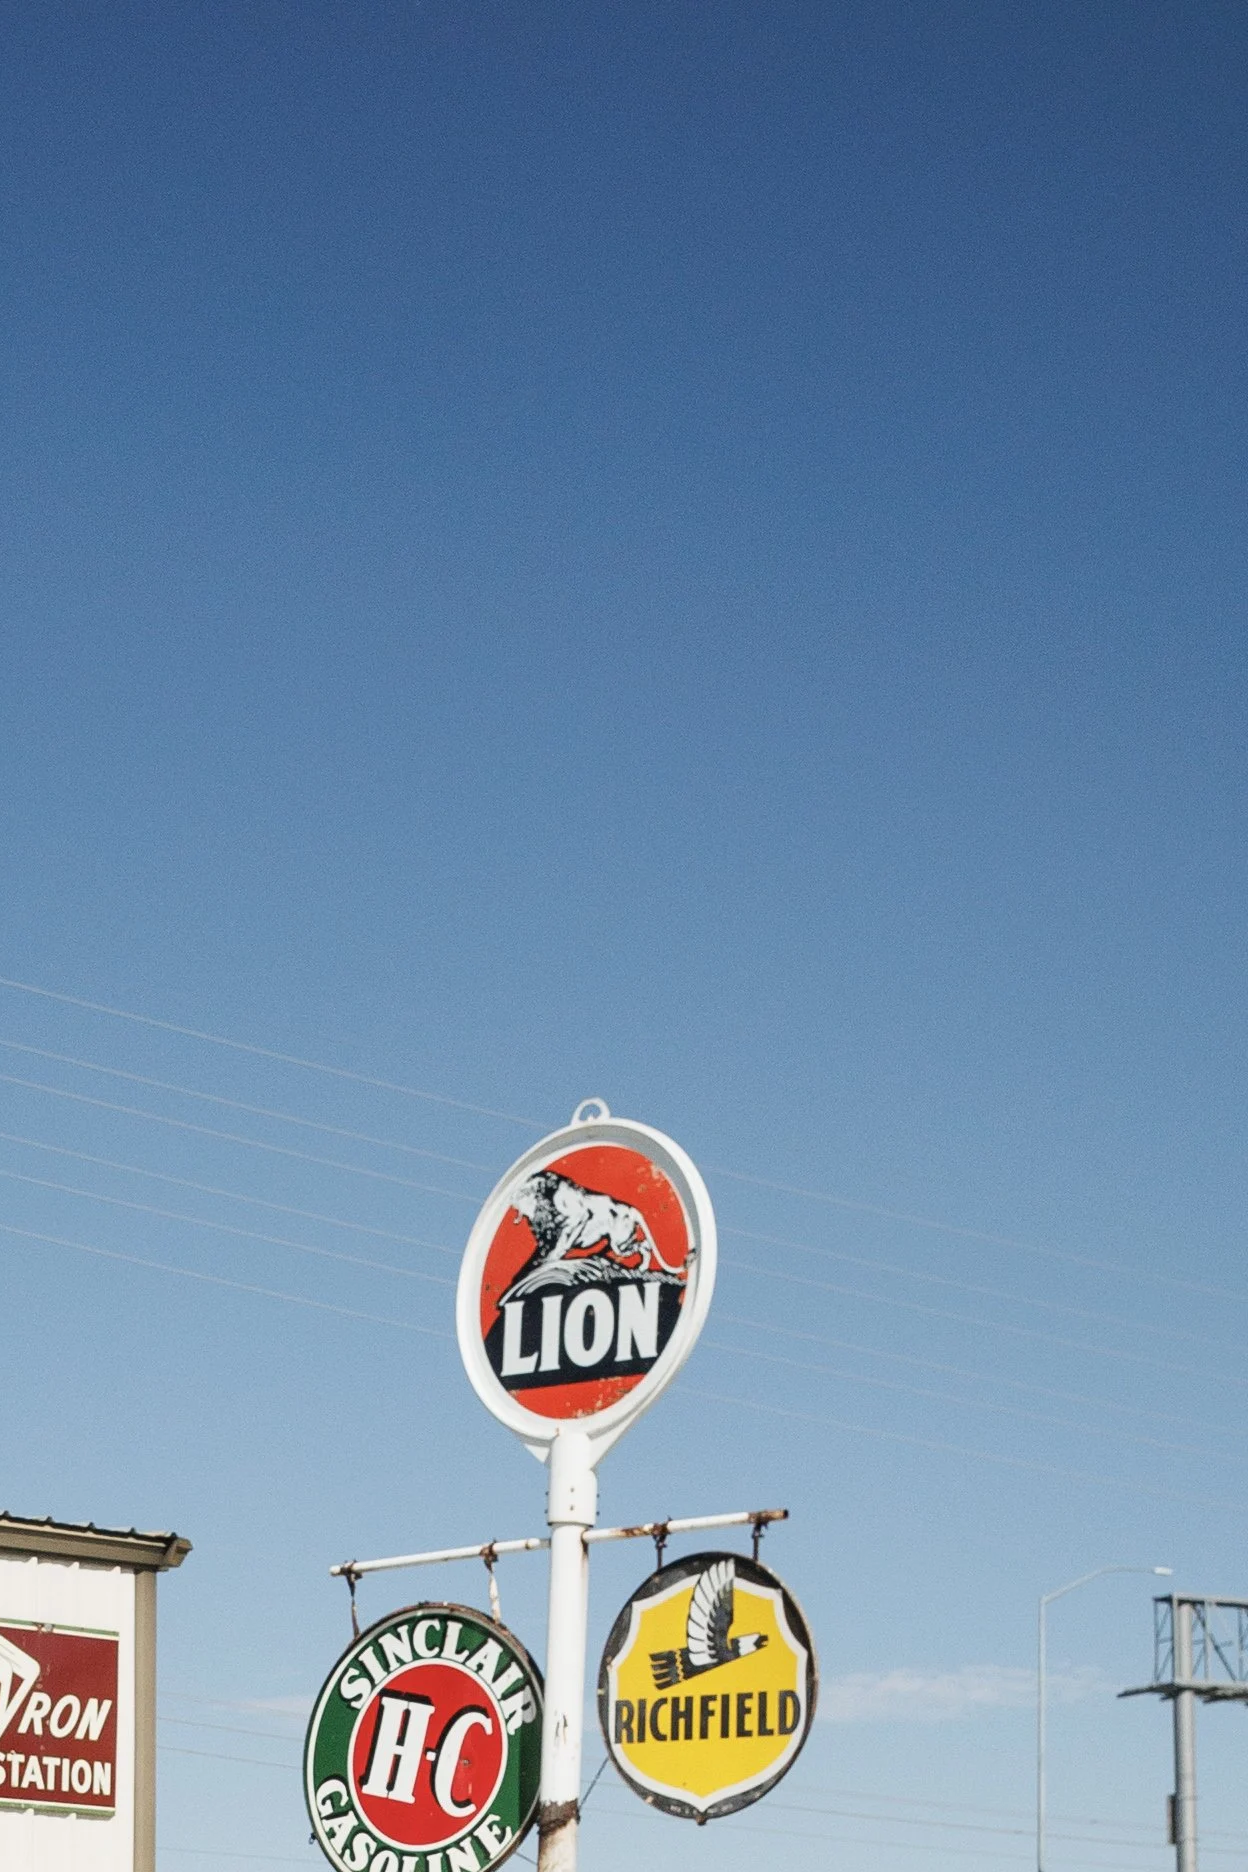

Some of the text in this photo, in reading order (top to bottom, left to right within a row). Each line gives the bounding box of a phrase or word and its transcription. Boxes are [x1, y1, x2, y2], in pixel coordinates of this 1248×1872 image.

[501, 1282, 661, 1376] LION
[339, 1617, 537, 1736] SINCLAIR
[614, 1689, 801, 1744] RICHFIELD
